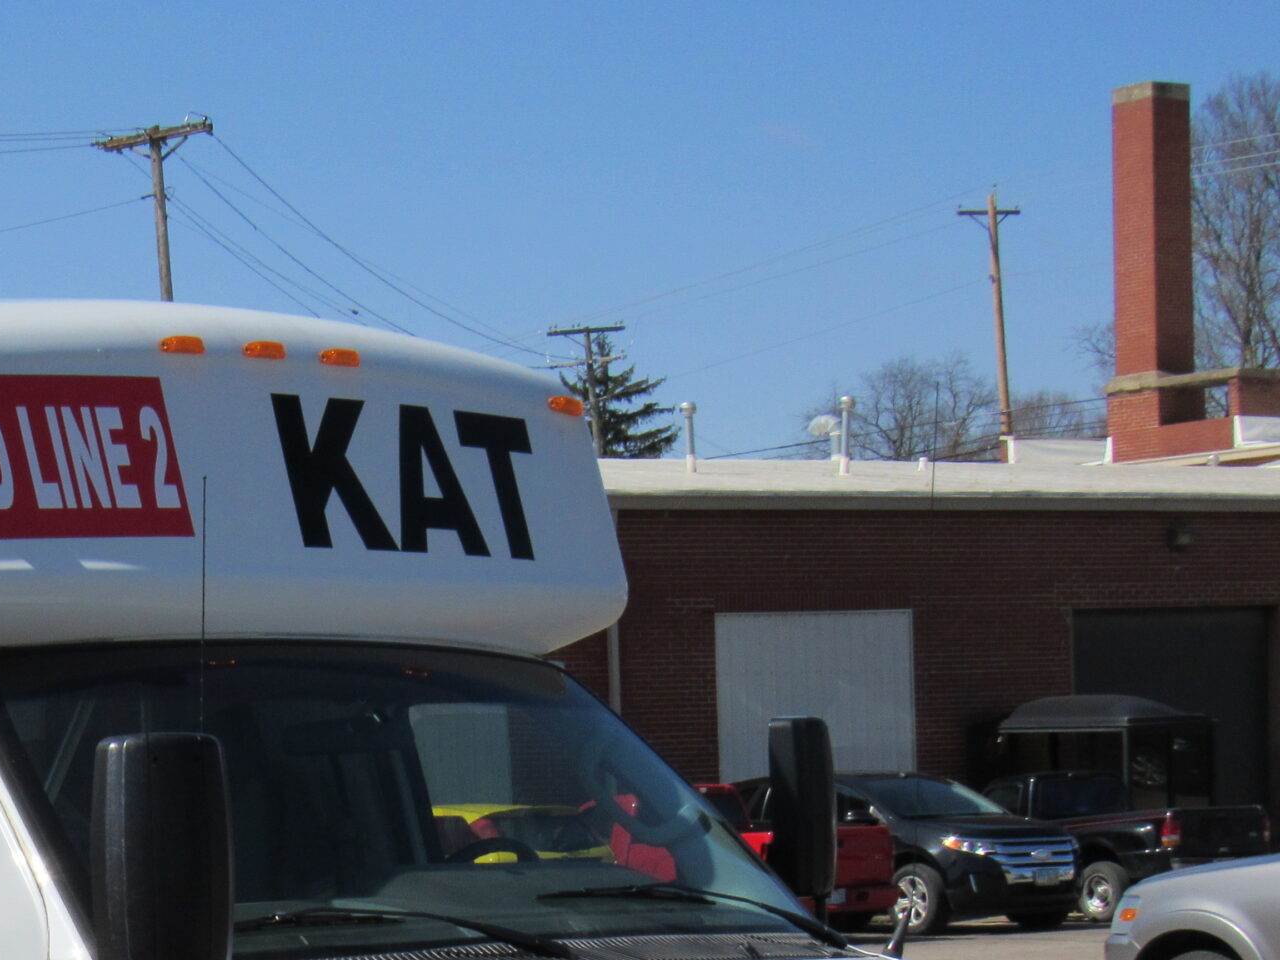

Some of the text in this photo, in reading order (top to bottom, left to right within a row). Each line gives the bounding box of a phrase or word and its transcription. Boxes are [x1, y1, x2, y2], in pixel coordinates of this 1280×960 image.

[16, 405, 142, 511] LINE
[139, 405, 182, 509] 2
[270, 392, 535, 561] KAT
